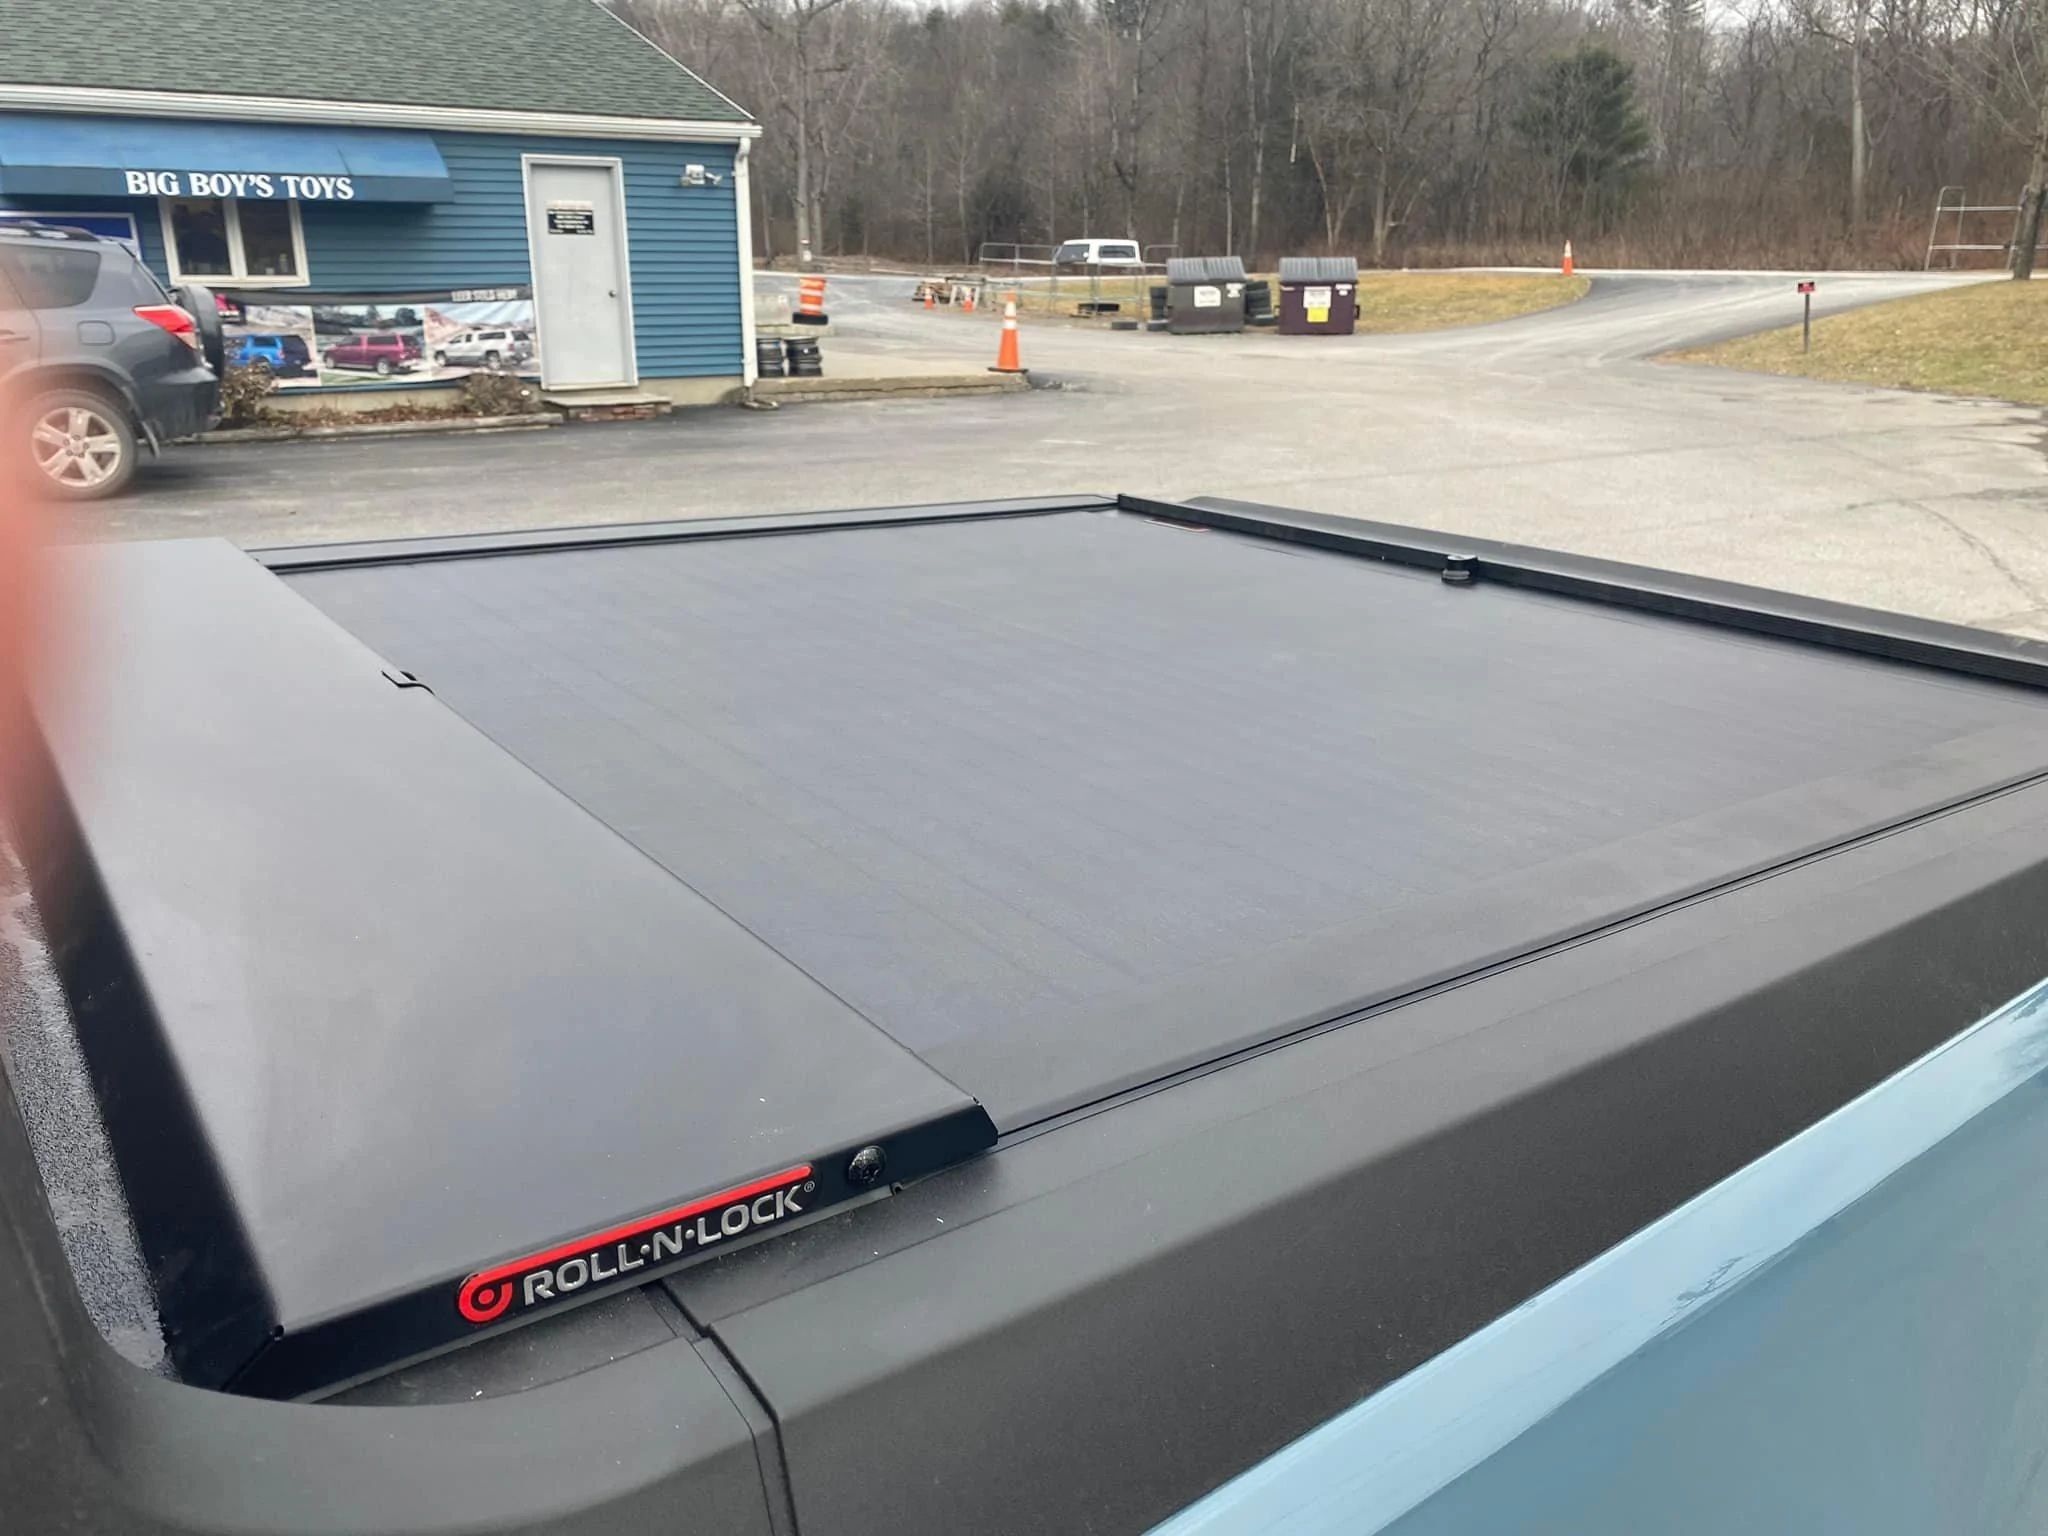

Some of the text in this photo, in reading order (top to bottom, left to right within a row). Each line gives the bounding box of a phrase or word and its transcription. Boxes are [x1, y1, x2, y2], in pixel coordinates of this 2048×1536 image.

[125, 170, 354, 200] BIG BOY'S TOYS
